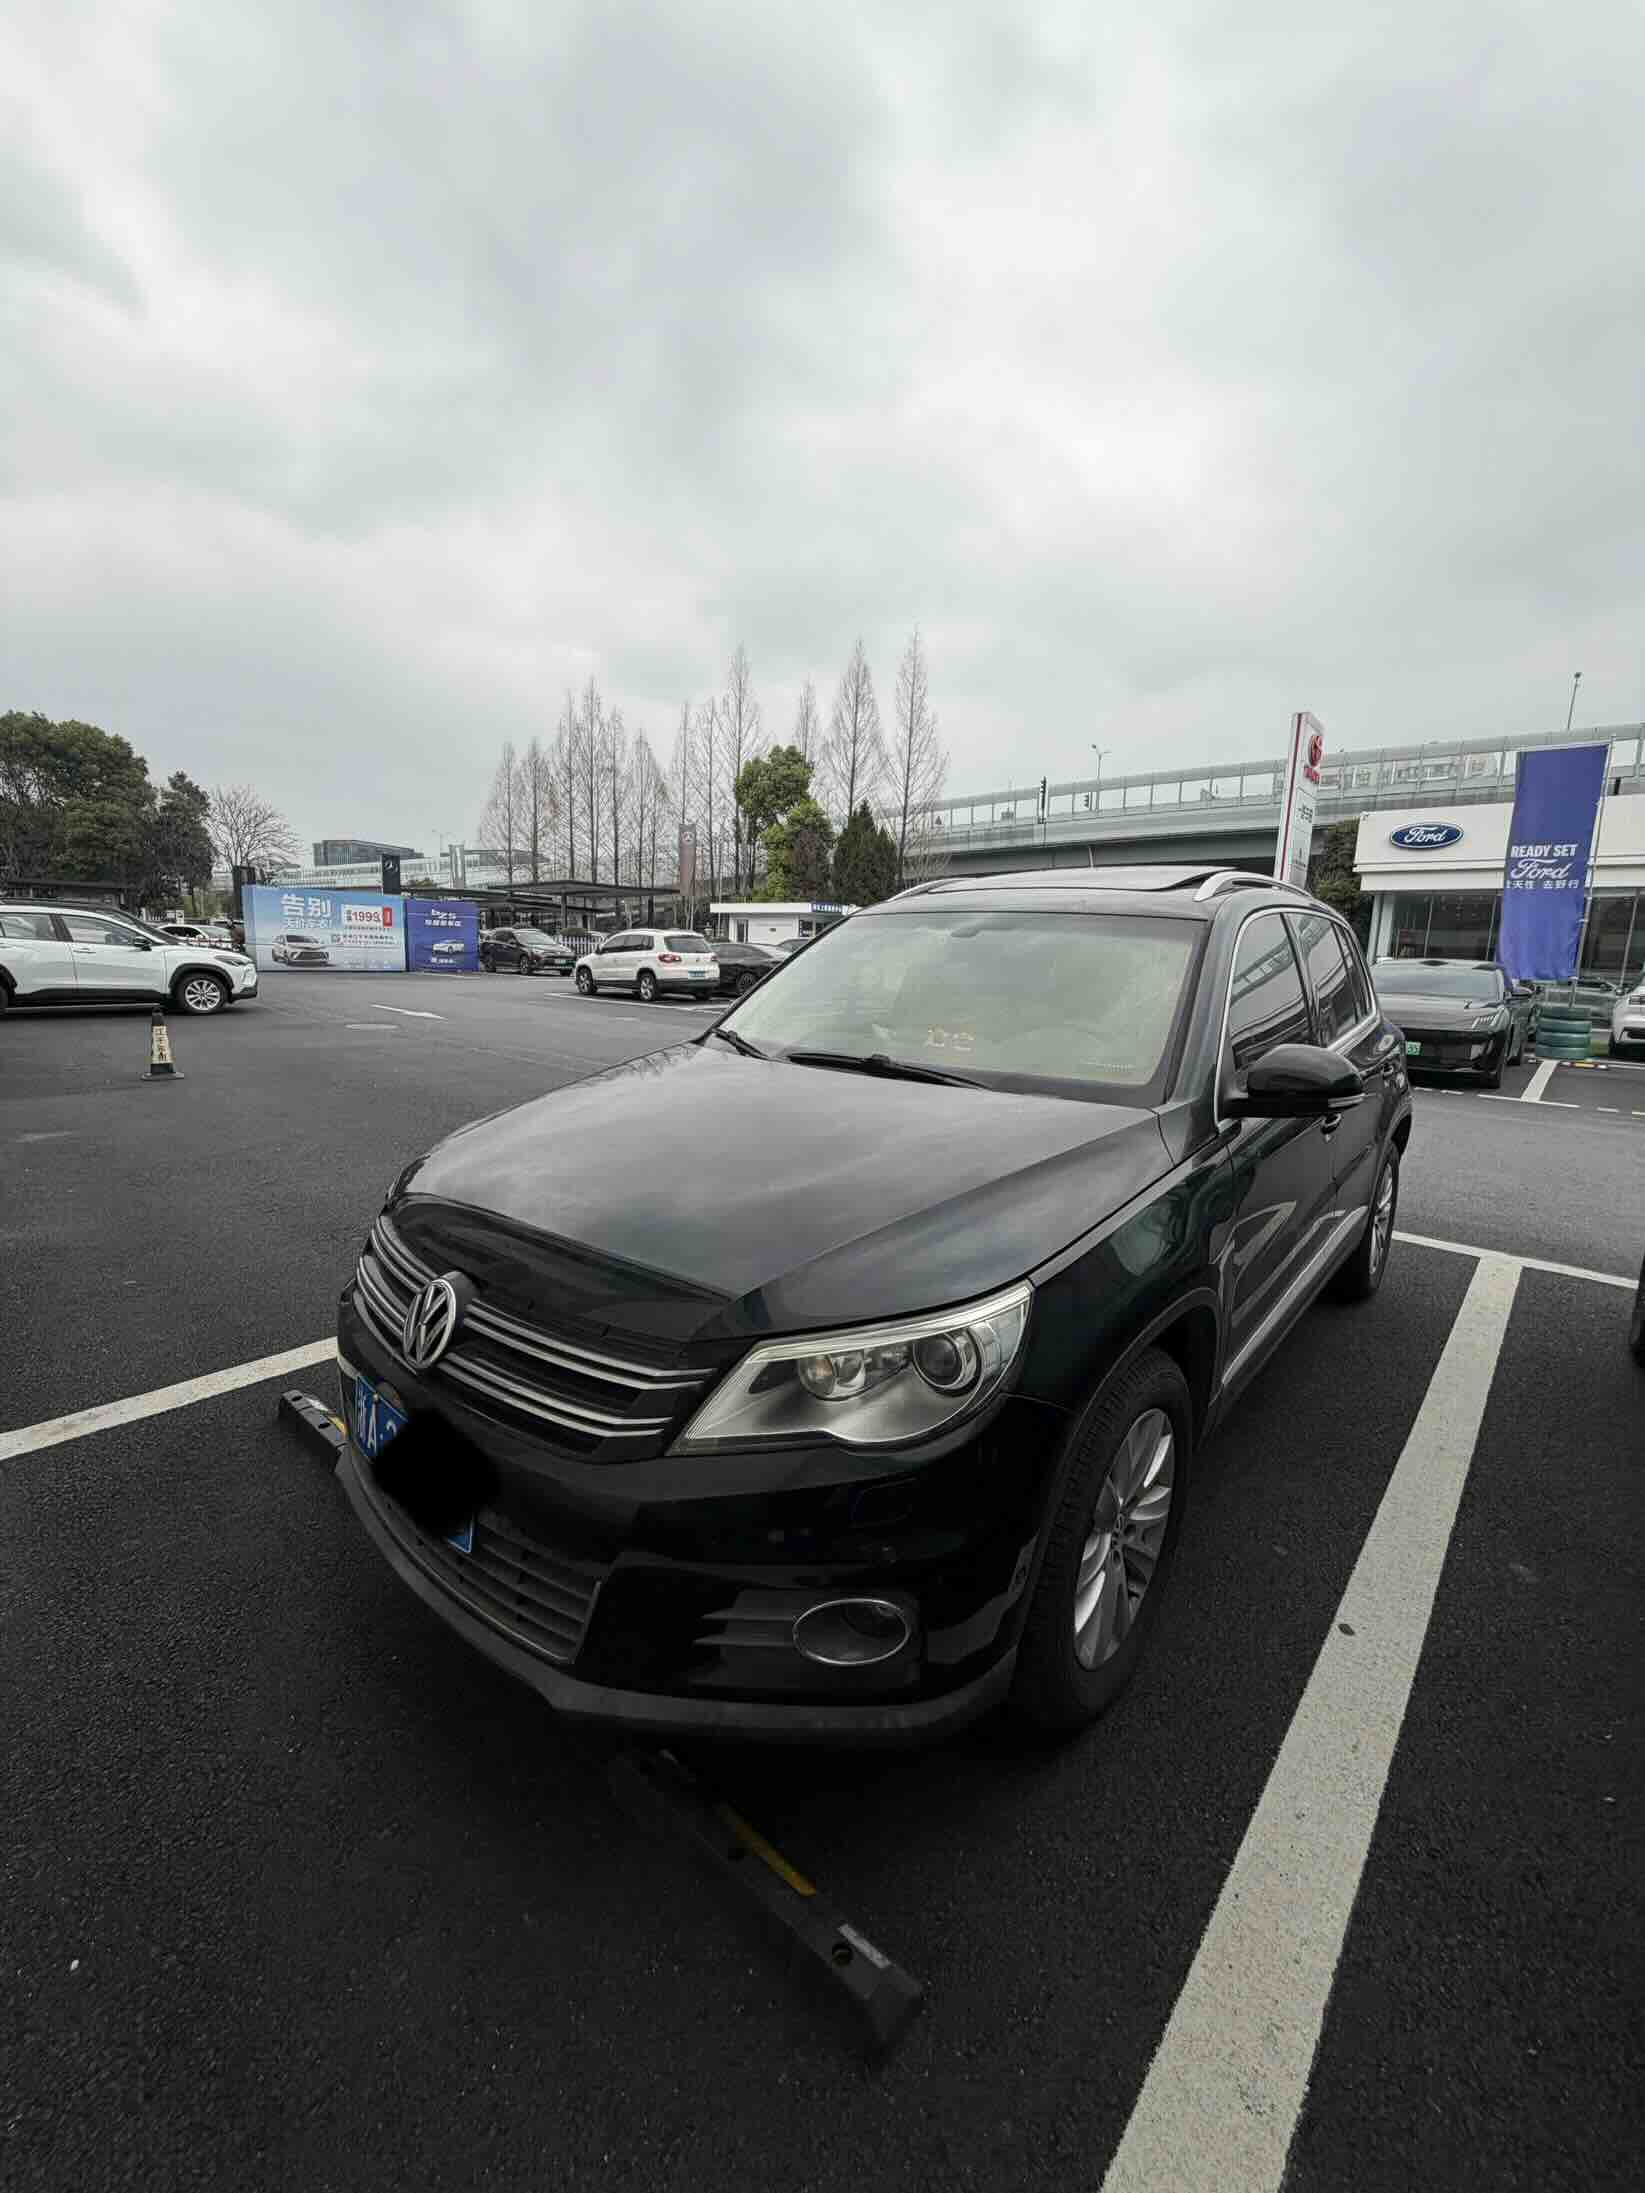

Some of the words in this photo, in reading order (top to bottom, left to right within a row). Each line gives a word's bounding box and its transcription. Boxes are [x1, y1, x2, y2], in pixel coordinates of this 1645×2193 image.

[1404, 827, 1448, 843] Ford
[1510, 845, 1551, 858] READY
[1552, 843, 1579, 857] SET
[1510, 858, 1574, 880] Ford
[281, 893, 331, 918] 告别
